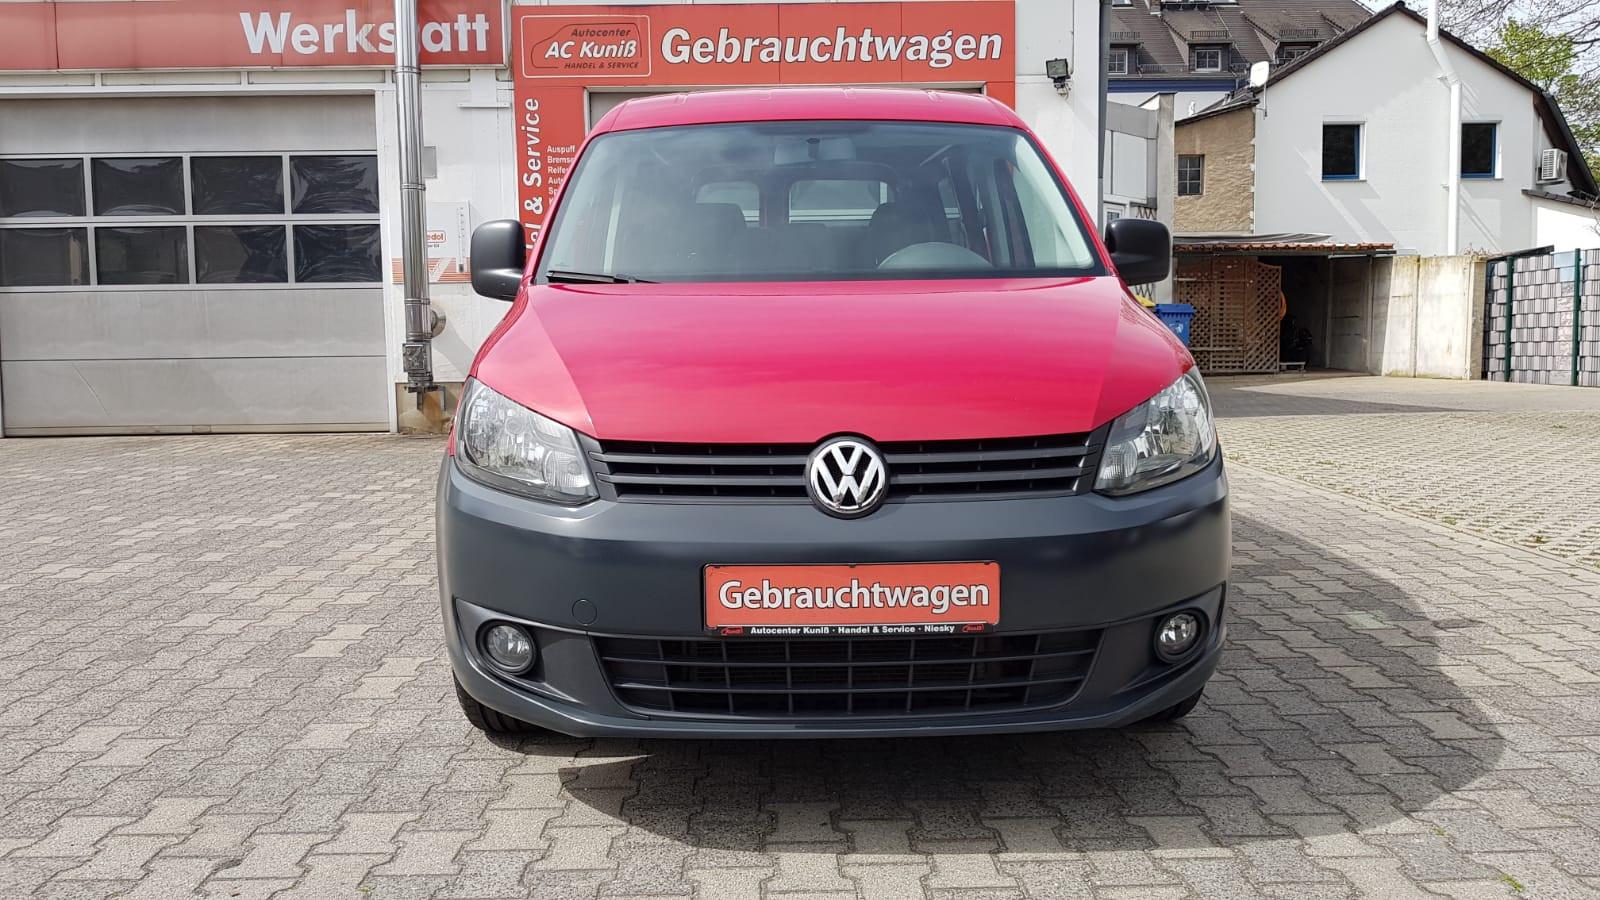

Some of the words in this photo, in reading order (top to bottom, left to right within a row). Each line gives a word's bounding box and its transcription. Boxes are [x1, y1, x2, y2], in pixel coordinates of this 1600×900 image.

[239, 9, 490, 54] Werksatt
[571, 28, 631, 38] Autocenter
[544, 41, 575, 59] AC
[579, 40, 637, 58] Kuniß
[660, 26, 1003, 69] Gebrauchtwagen
[564, 62, 596, 70] HANDEL
[607, 61, 639, 69] SERVICE
[521, 98, 542, 188] Service
[547, 145, 576, 155] Auspuff
[547, 156, 575, 164] Bremse
[547, 166, 569, 174] Reife
[524, 196, 543, 215] &
[719, 578, 990, 614] Gebrauchtwagen
[838, 626, 870, 634] Handel
[882, 625, 916, 634] Service
[924, 624, 955, 633] Niesky
